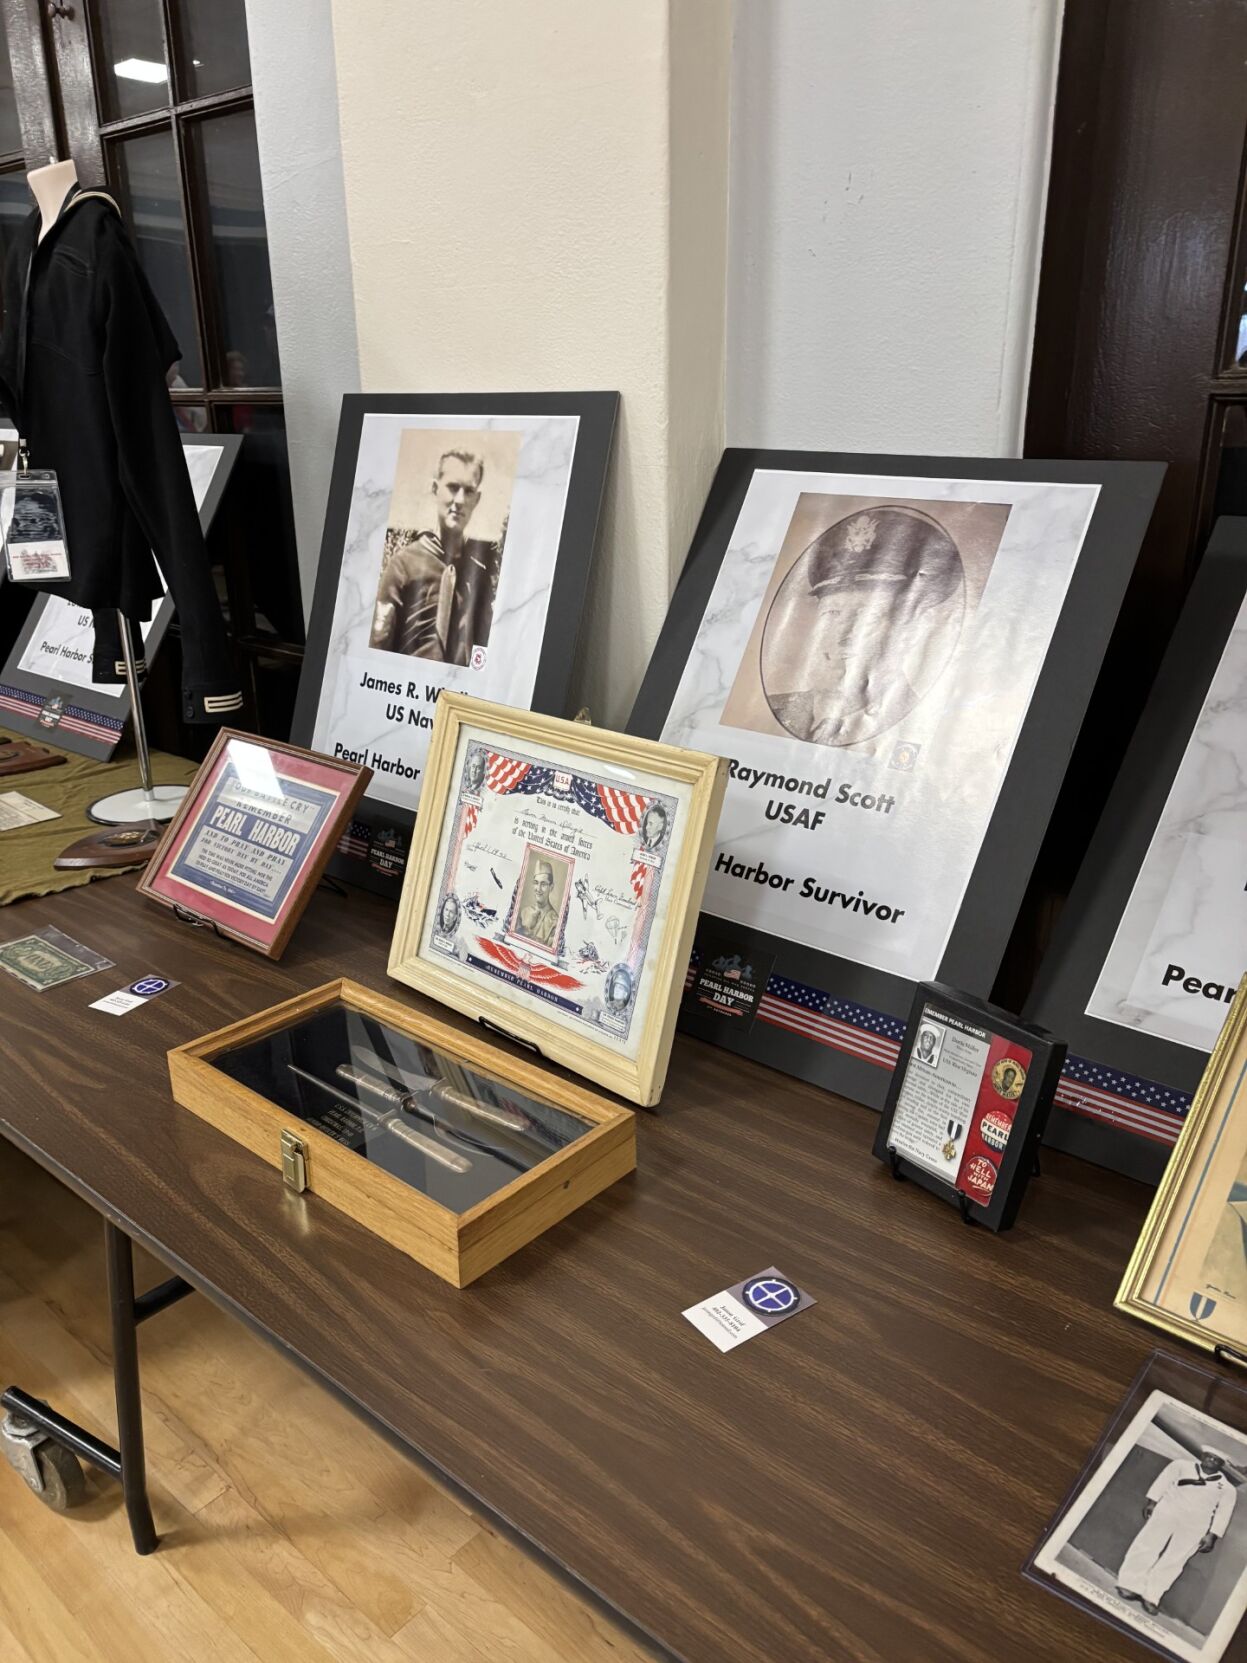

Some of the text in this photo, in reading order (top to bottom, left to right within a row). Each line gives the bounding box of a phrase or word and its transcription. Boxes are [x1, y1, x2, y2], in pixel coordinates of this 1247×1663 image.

[77, 615, 89, 627] US
[40, 641, 61, 655] Pearl
[60, 646, 86, 661] Harbor
[360, 671, 402, 695] James
[406, 681, 419, 699] R.
[386, 703, 404, 722] US
[334, 742, 421, 780] Pearl Harbor
[729, 758, 896, 814] Raymond Scott
[765, 800, 826, 830] USAF
[210, 805, 301, 855] PEARL HARBOR
[715, 852, 906, 924] Harbor Survivor
[700, 978, 722, 991] PEARL
[723, 986, 754, 1003] HARBOR
[1161, 963, 1237, 1004] Pear
[713, 992, 735, 1006] DAY
[924, 1006, 986, 1039] EMEMBER PEARL HARBOR
[982, 1122, 1009, 1140] PEARL
[970, 1163, 991, 1178] HELL
[978, 1159, 987, 1168] TO
[967, 1175, 994, 1191] JAPAN
